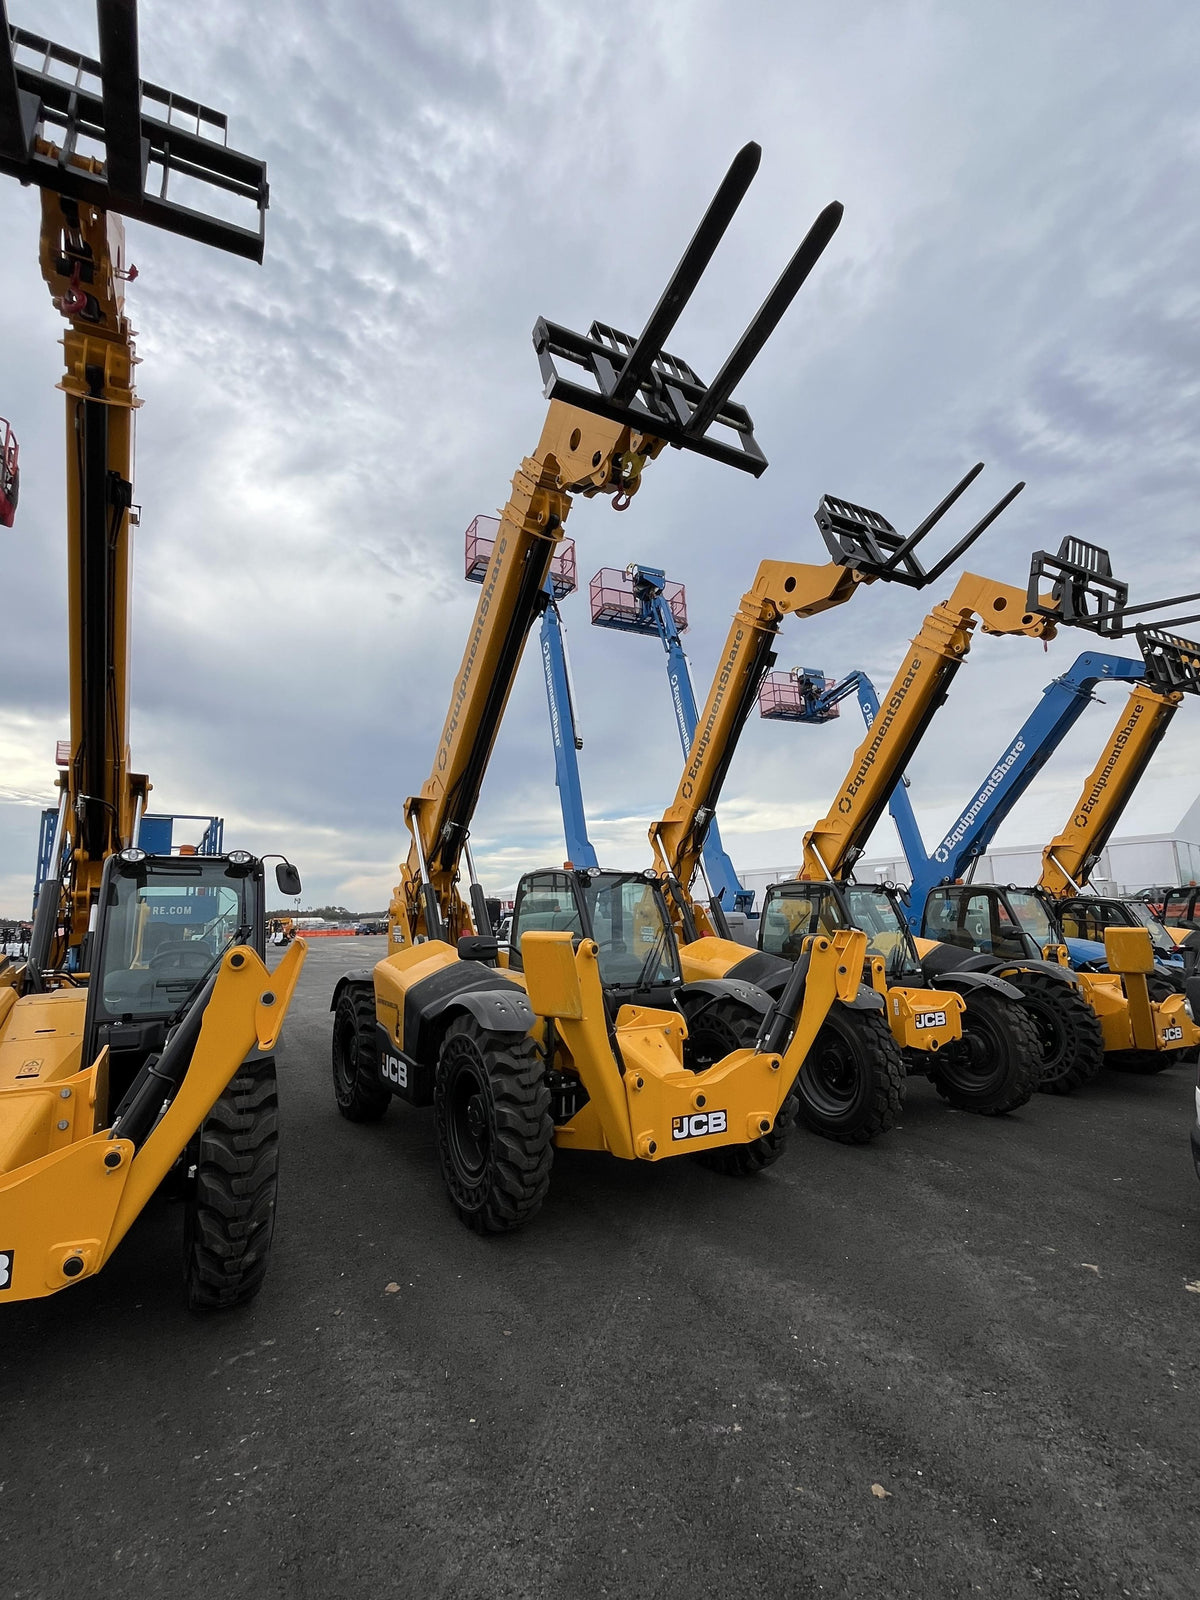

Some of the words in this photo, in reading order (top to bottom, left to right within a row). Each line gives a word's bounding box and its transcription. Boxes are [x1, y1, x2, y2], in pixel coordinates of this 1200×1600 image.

[444, 537, 507, 747] EquipmentShare
[544, 654, 561, 747] EquipmentShare
[688, 629, 744, 781] EquipmentShare
[847, 658, 922, 798] EquipmentShare
[944, 740, 1026, 851] EquipmentShare
[1081, 704, 1144, 814] EquipmentShare
[381, 1053, 408, 1088] JCB
[915, 1011, 946, 1029] JCB
[1163, 1027, 1183, 1041] JCB
[673, 1111, 727, 1139] JCB
